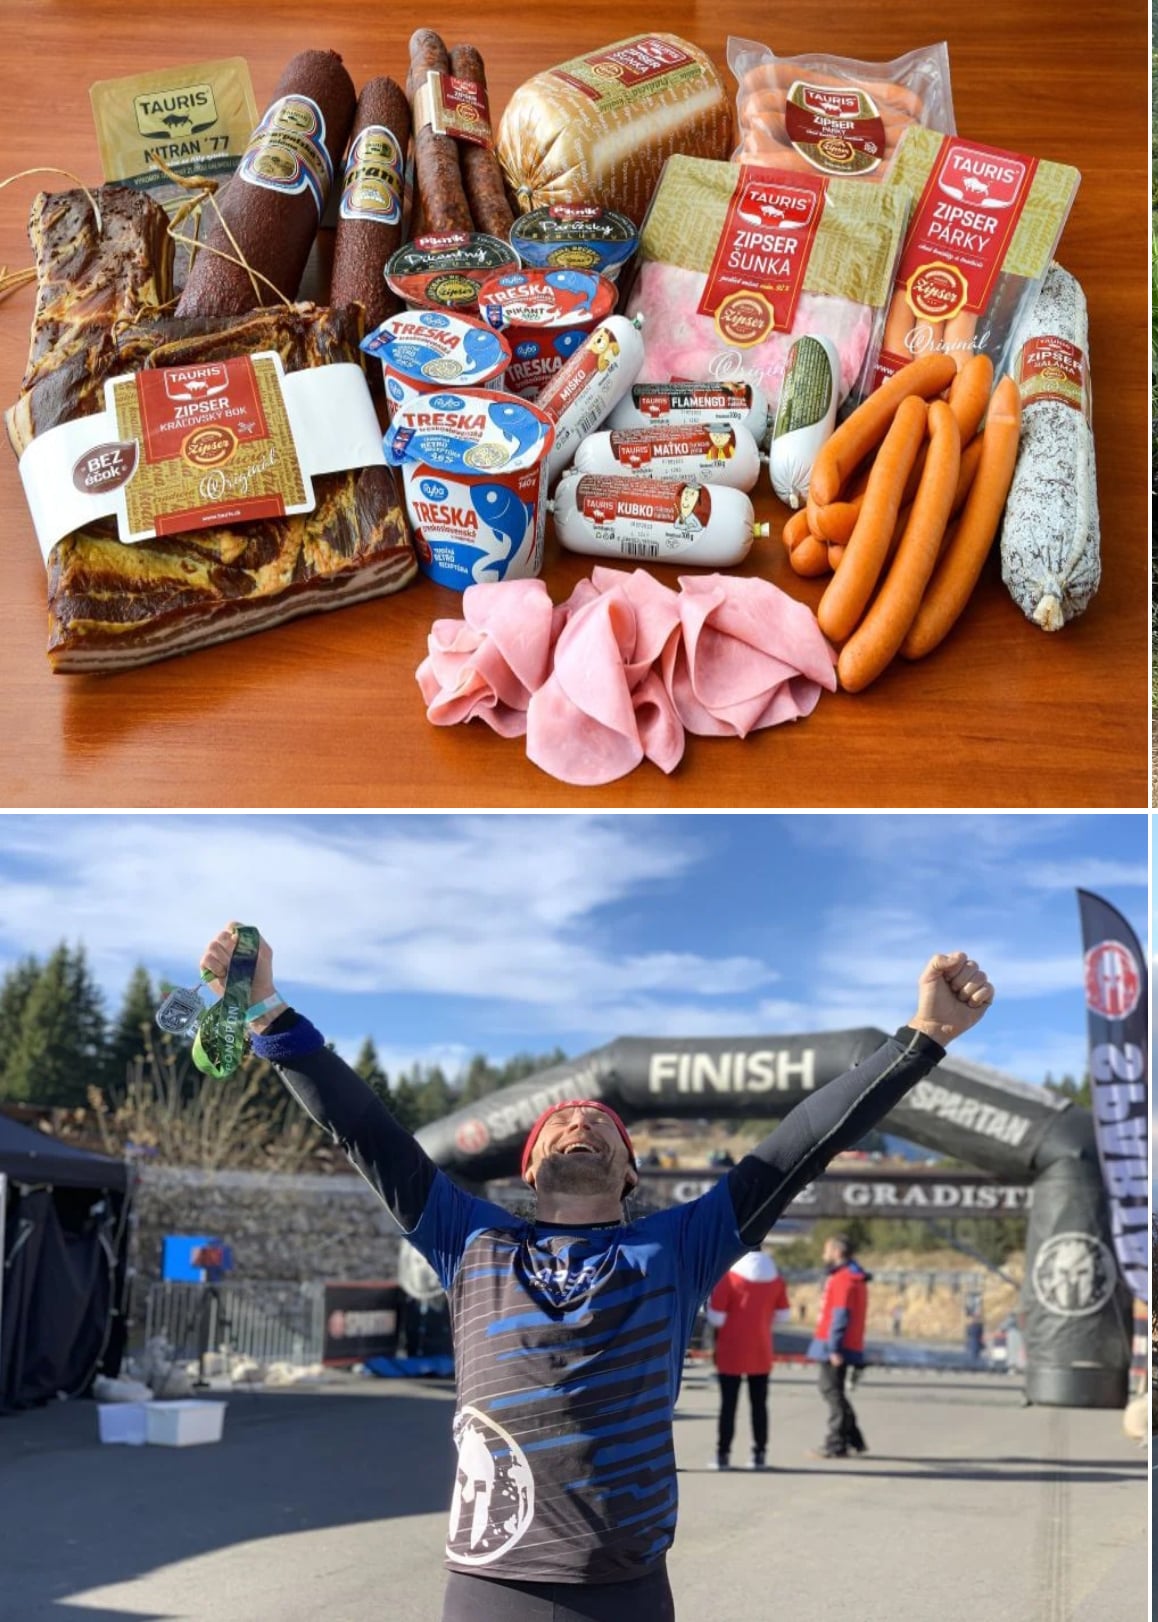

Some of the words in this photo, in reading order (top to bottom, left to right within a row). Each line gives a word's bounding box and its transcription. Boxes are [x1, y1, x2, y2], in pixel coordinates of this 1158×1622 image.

[140, 92, 208, 115] TAURIS
[808, 91, 855, 107] TAURIS
[813, 115, 855, 130] ZIPSER
[144, 140, 200, 163] NITRAN
[953, 155, 1015, 184] TAURIS
[750, 191, 807, 211] TAURIS
[933, 201, 998, 234] ZIPSER
[733, 230, 799, 255] ZIPSER
[927, 221, 991, 252] PÁRKY
[728, 246, 791, 276] ŠUNKA
[484, 284, 555, 305] TRESKA
[913, 278, 958, 303] Zipser
[505, 307, 545, 317] PIKANT
[721, 308, 765, 329] Zipser
[391, 321, 461, 349] TRESKA
[904, 325, 991, 355] Originál
[506, 356, 563, 382] TRESKA
[1026, 351, 1083, 370] ZIPSER
[169, 366, 221, 383] TAURIS
[174, 397, 230, 419] ZIPSER
[224, 406, 247, 418] BOK
[434, 398, 461, 409] Ryba
[671, 396, 725, 408] FLAMENGO
[402, 413, 487, 431] TRESKA
[187, 438, 230, 456] Zipser
[621, 446, 648, 455] TAURIS
[653, 441, 689, 456] MAŤKO
[87, 450, 123, 473] BEZ
[84, 466, 121, 486] éčok
[199, 446, 278, 500] Originál
[423, 483, 445, 497] Ryba
[412, 501, 478, 530] TRESKA
[586, 499, 614, 511] TAURIS
[617, 501, 653, 518] KUBKO
[649, 1049, 815, 1093] FINISH
[910, 1079, 1031, 1147] SPARTAN
